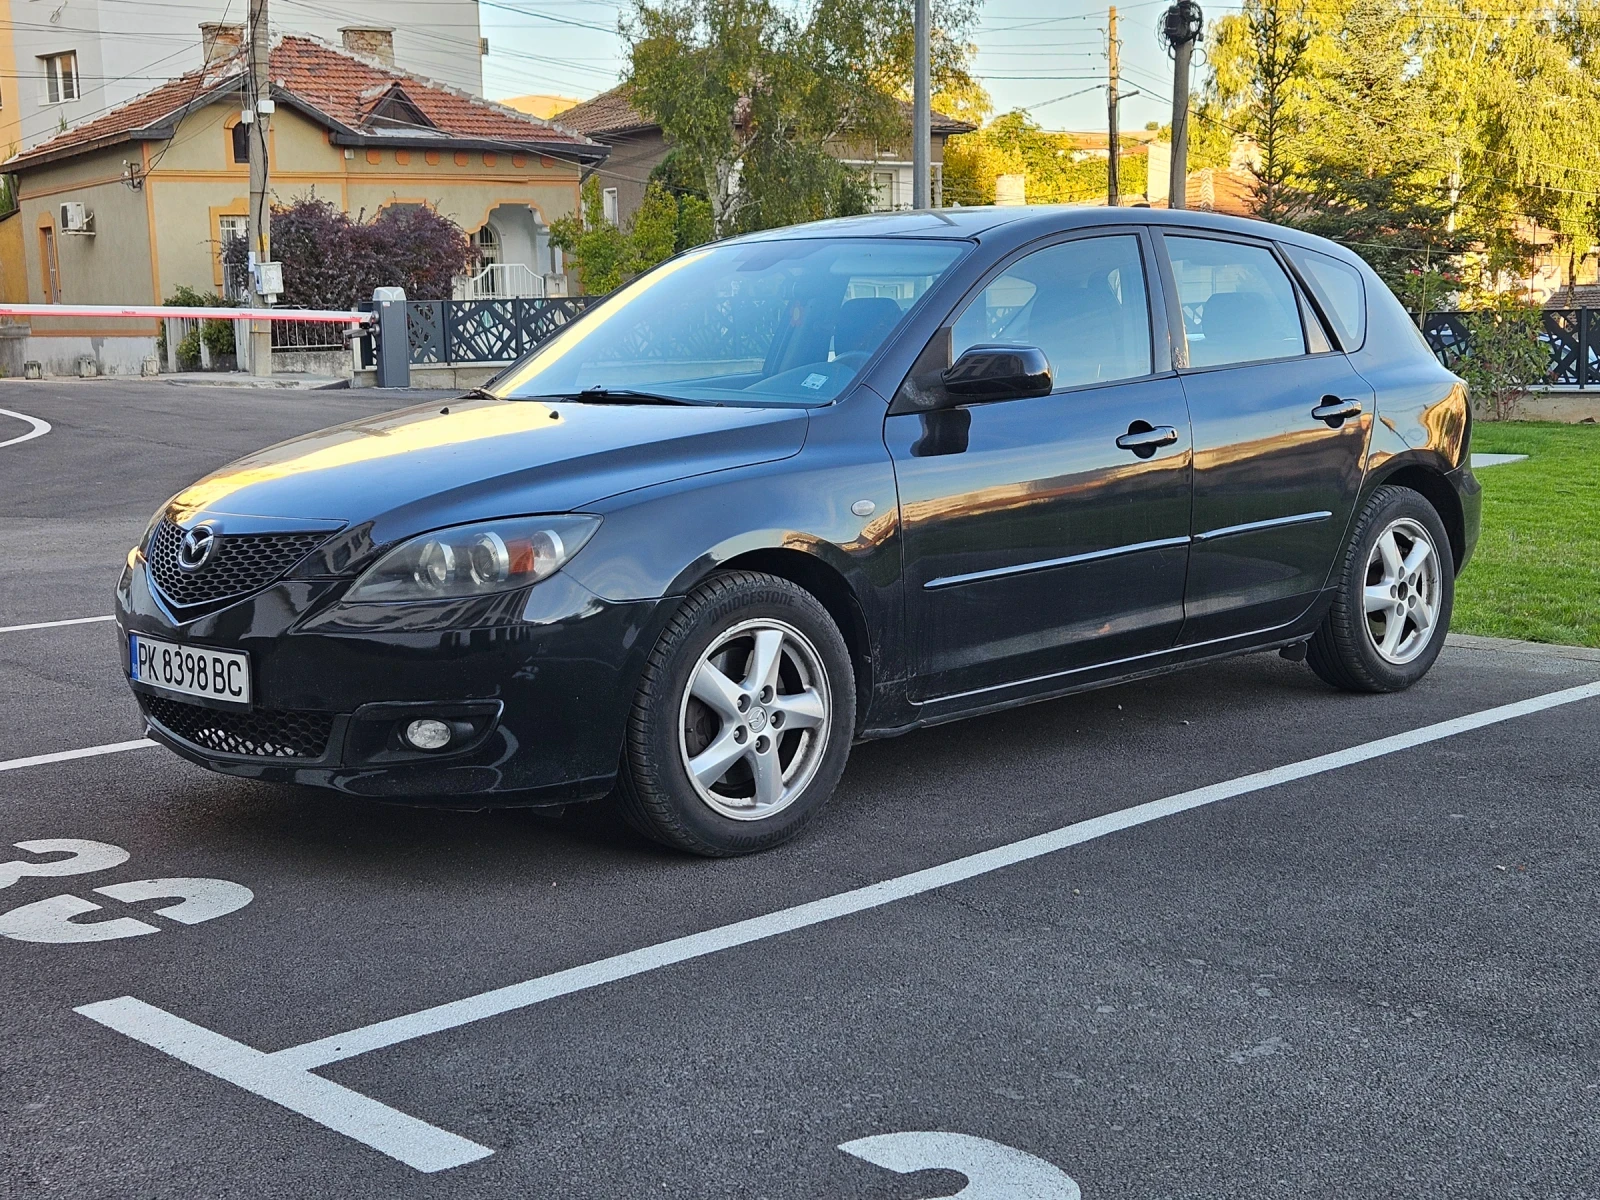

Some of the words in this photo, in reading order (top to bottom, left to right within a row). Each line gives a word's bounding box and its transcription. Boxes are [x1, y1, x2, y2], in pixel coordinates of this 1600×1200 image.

[708, 590, 796, 625] BRIDGESTONE
[138, 642, 159, 682] PK
[162, 648, 209, 691] 8398
[212, 657, 243, 697] BC
